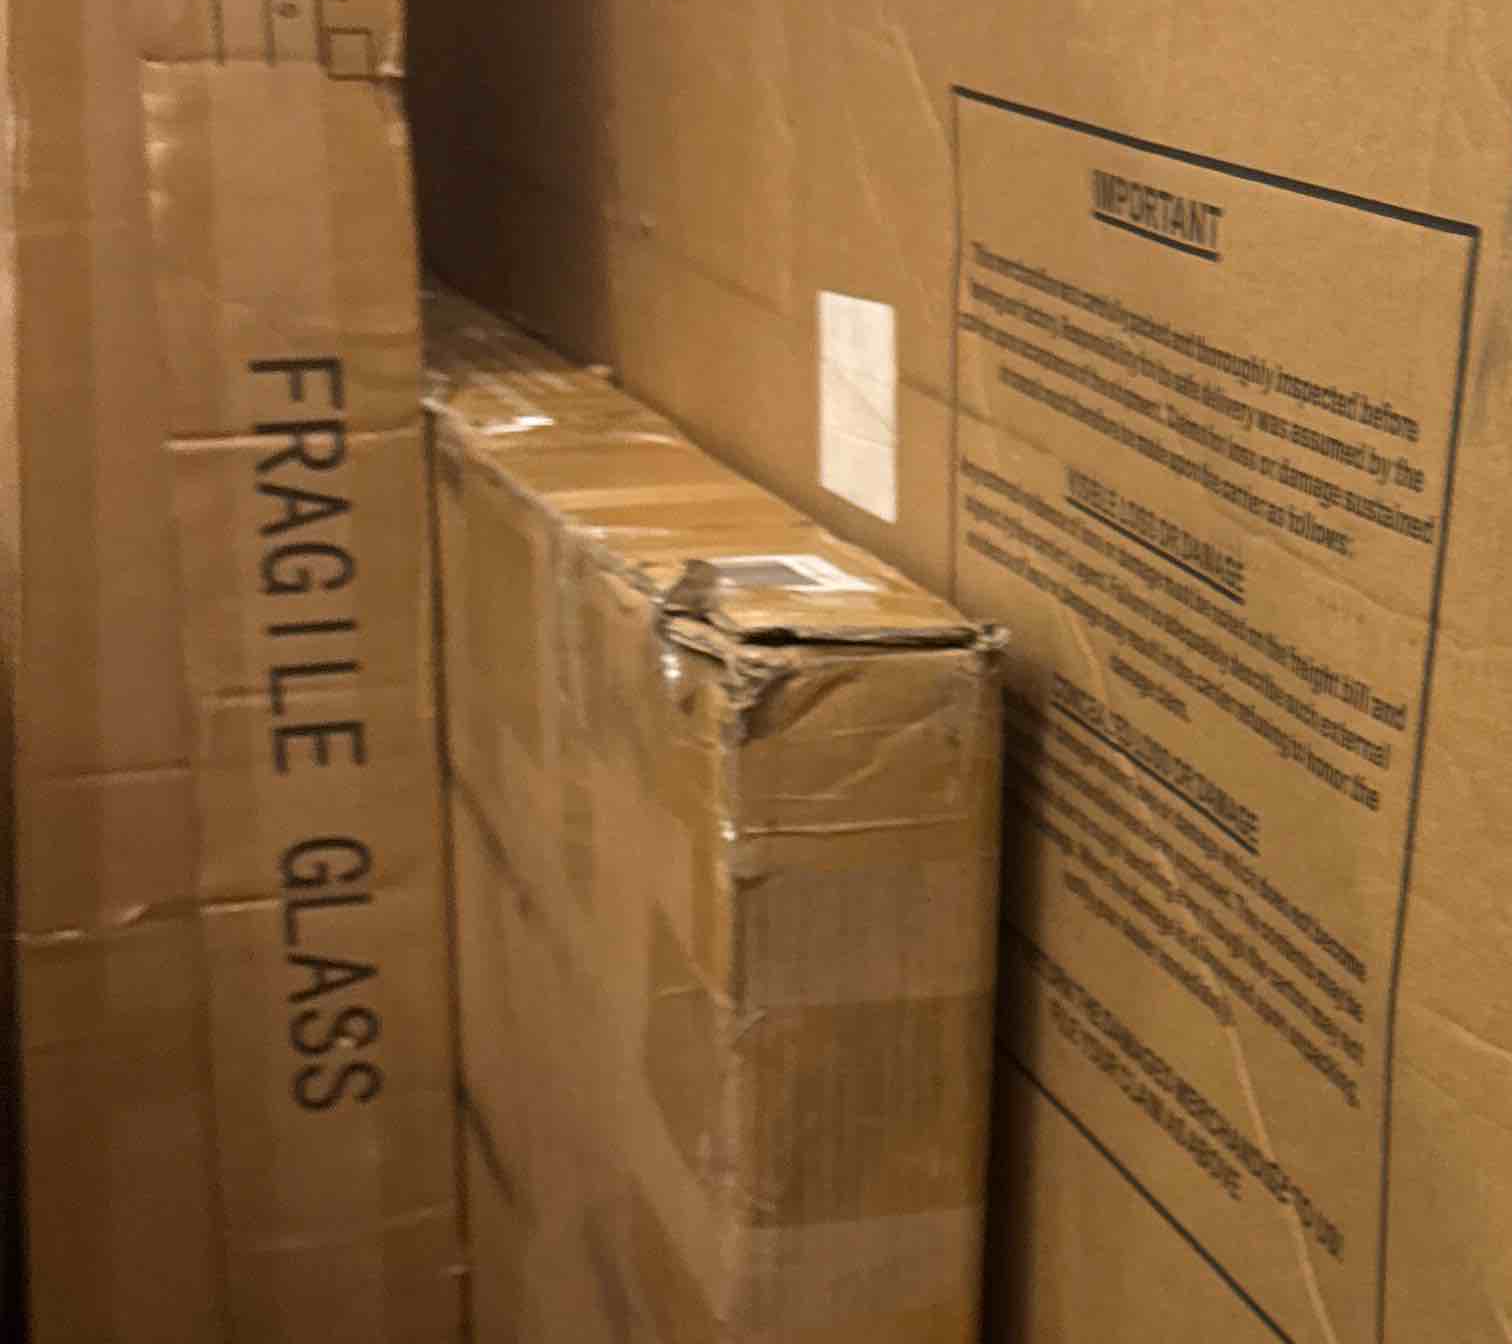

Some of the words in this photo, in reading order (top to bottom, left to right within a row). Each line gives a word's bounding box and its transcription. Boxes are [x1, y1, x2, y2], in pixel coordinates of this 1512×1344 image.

[1091, 169, 1223, 250] IMPORTANT
[248, 356, 366, 776] FRAGILE
[274, 836, 384, 1115] GLASS
